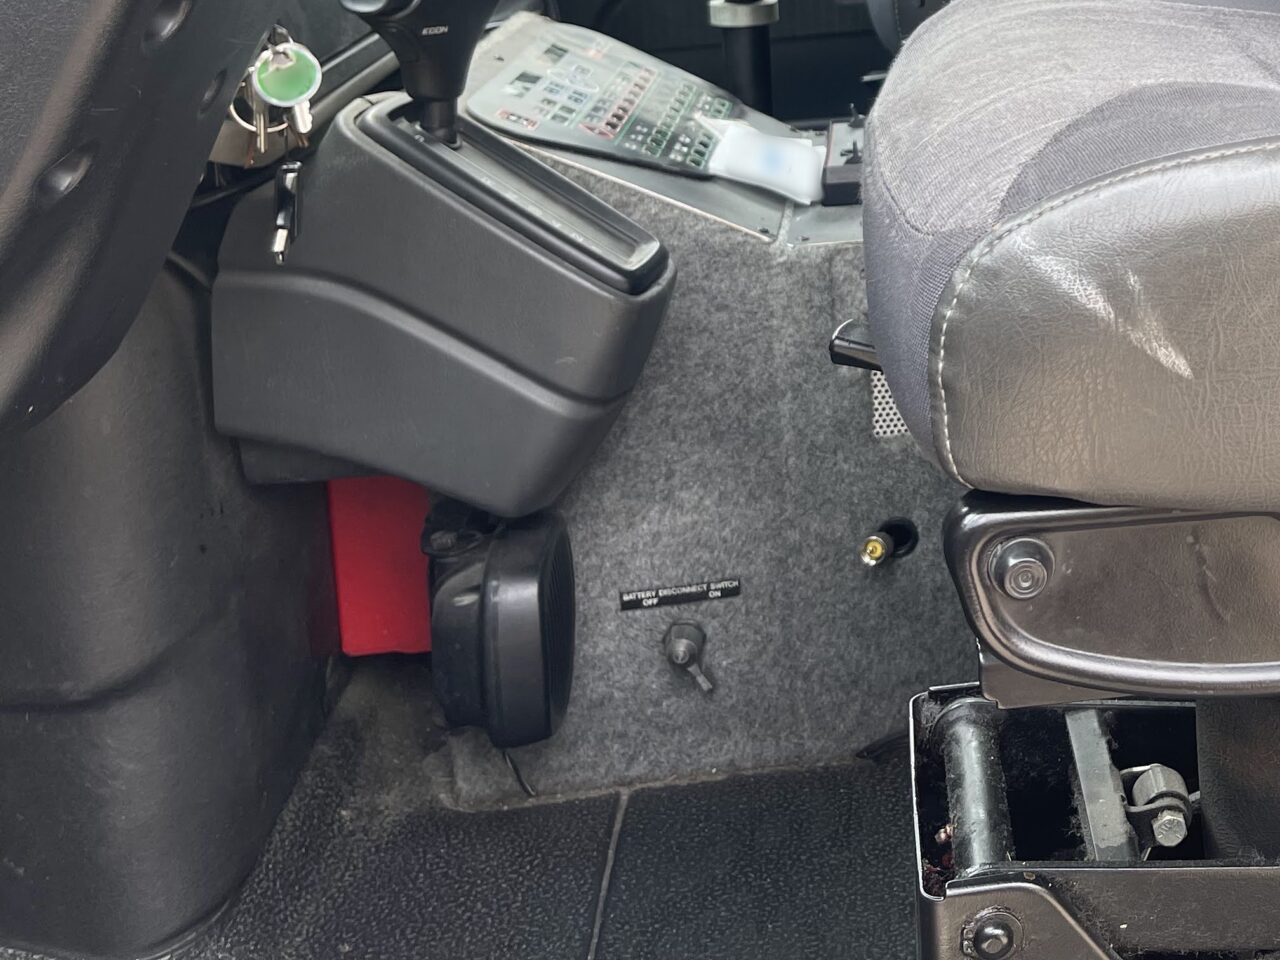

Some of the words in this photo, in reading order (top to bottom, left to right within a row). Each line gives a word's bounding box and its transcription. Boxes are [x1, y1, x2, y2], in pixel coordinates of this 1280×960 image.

[622, 590, 657, 601] BATTERY
[658, 584, 708, 597] DISCONNECT
[710, 580, 739, 590] SWITCH
[642, 597, 659, 606] OFF
[708, 590, 721, 598] ON
